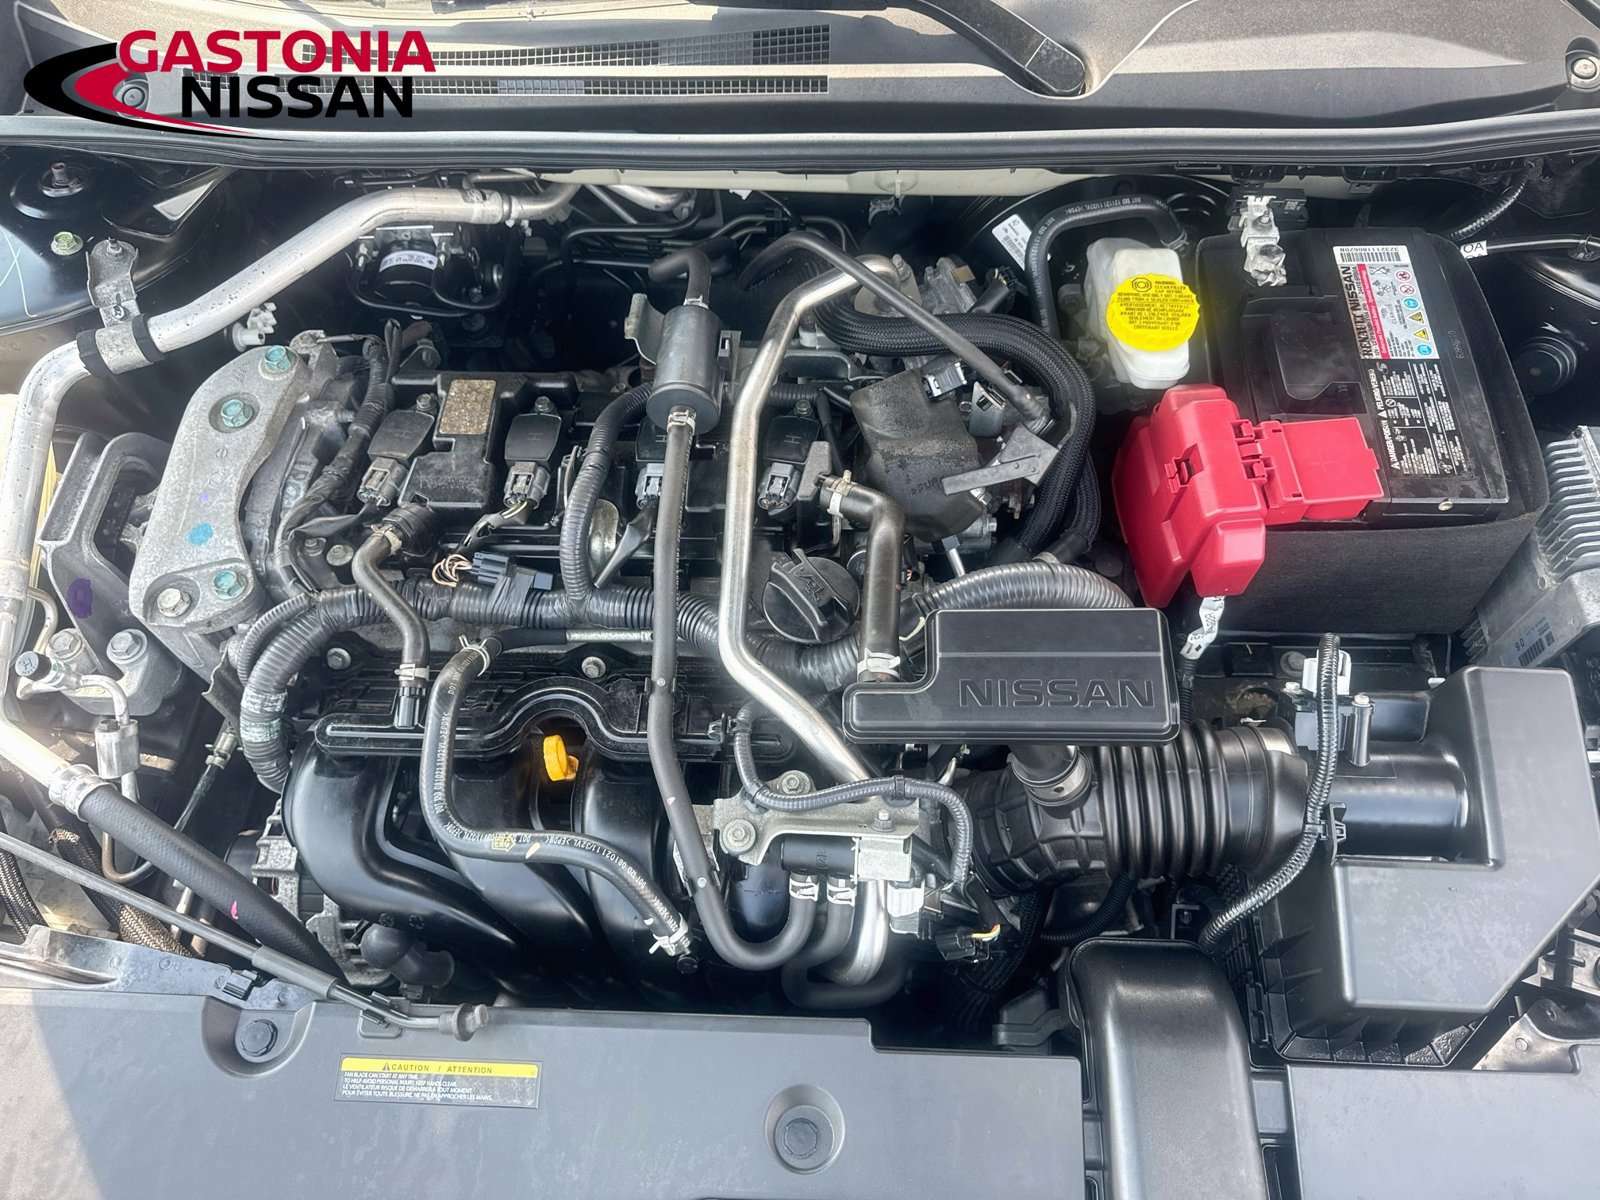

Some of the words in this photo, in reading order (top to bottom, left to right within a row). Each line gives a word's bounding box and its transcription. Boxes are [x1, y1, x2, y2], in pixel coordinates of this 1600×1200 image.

[1340, 266, 1361, 310] NISSAN
[1352, 314, 1373, 356] RENAULT
[958, 678, 1155, 708] NISSAN
[573, 838, 601, 853] 11/32VL
[601, 848, 627, 869] 081021
